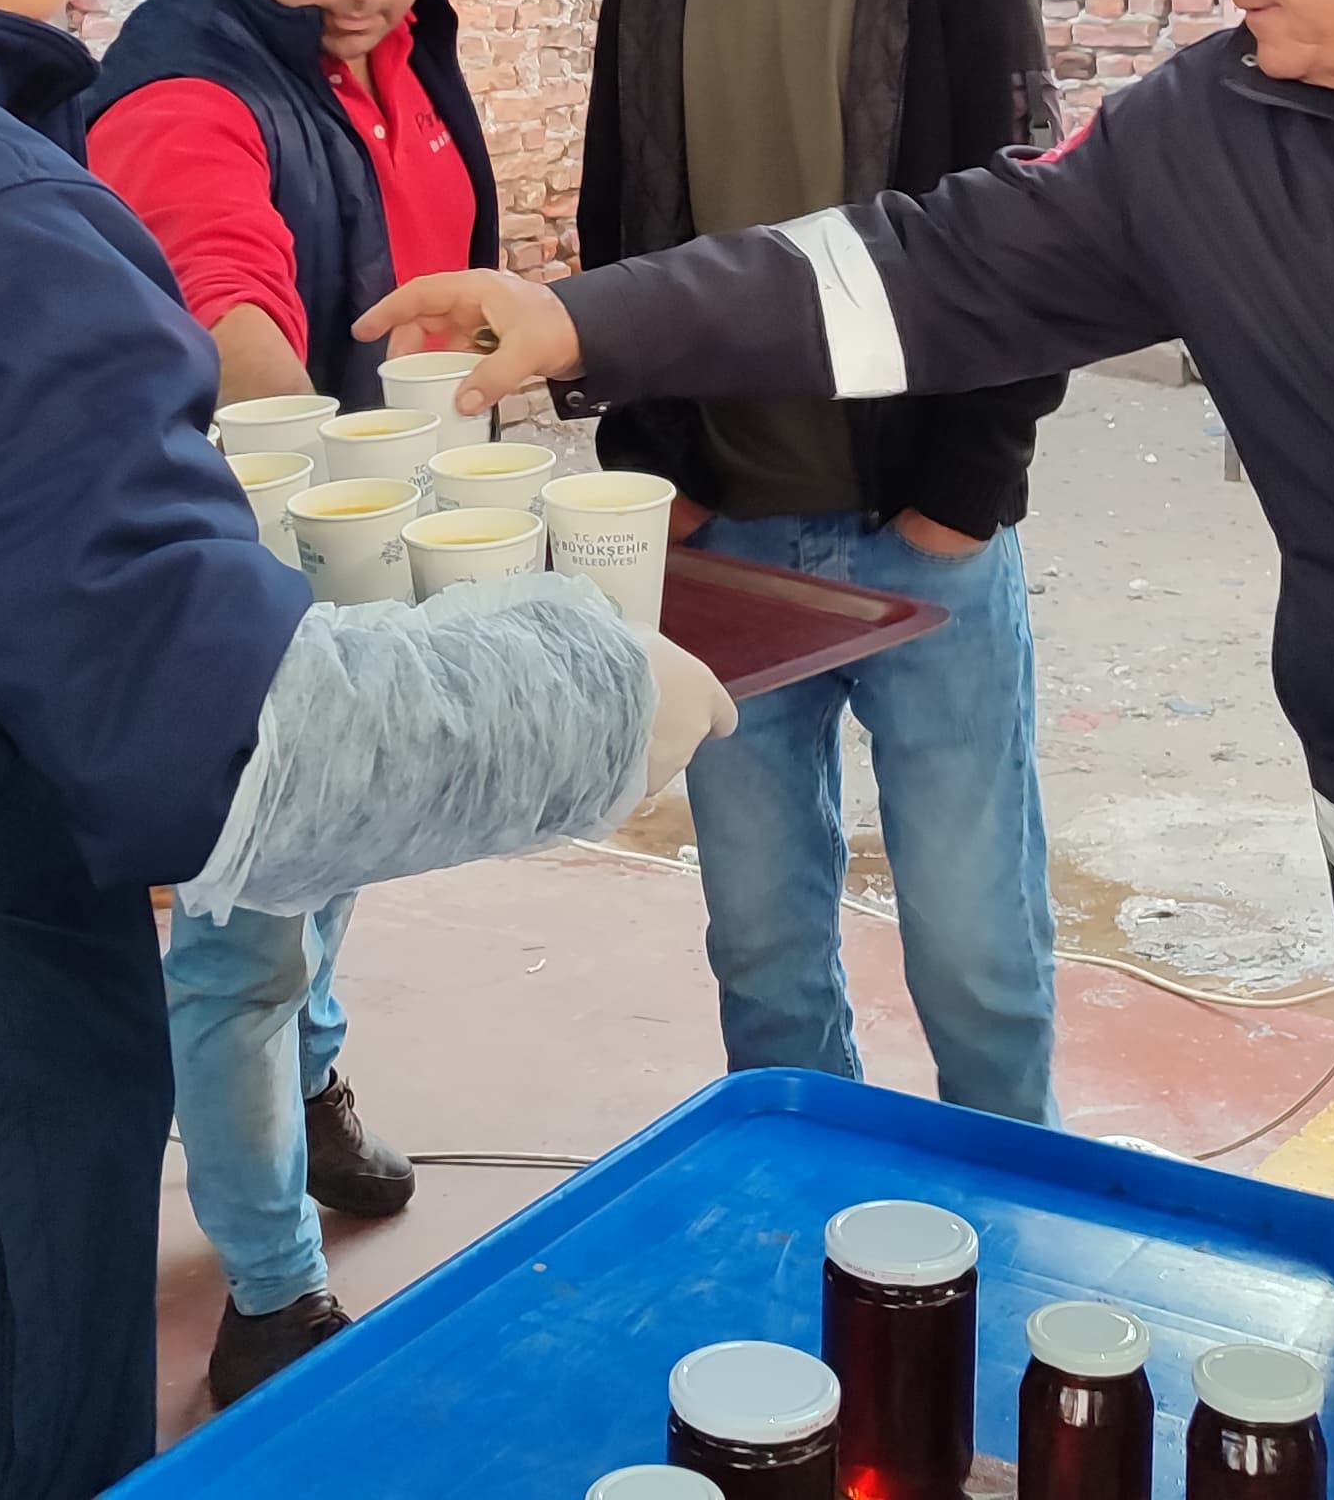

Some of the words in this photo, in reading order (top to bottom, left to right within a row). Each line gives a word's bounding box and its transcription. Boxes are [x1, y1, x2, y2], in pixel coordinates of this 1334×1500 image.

[597, 533, 634, 543] AYDIN
[561, 541, 648, 558] BÜYÜKŞEHİR
[572, 555, 636, 567] BELEDİYESİ
